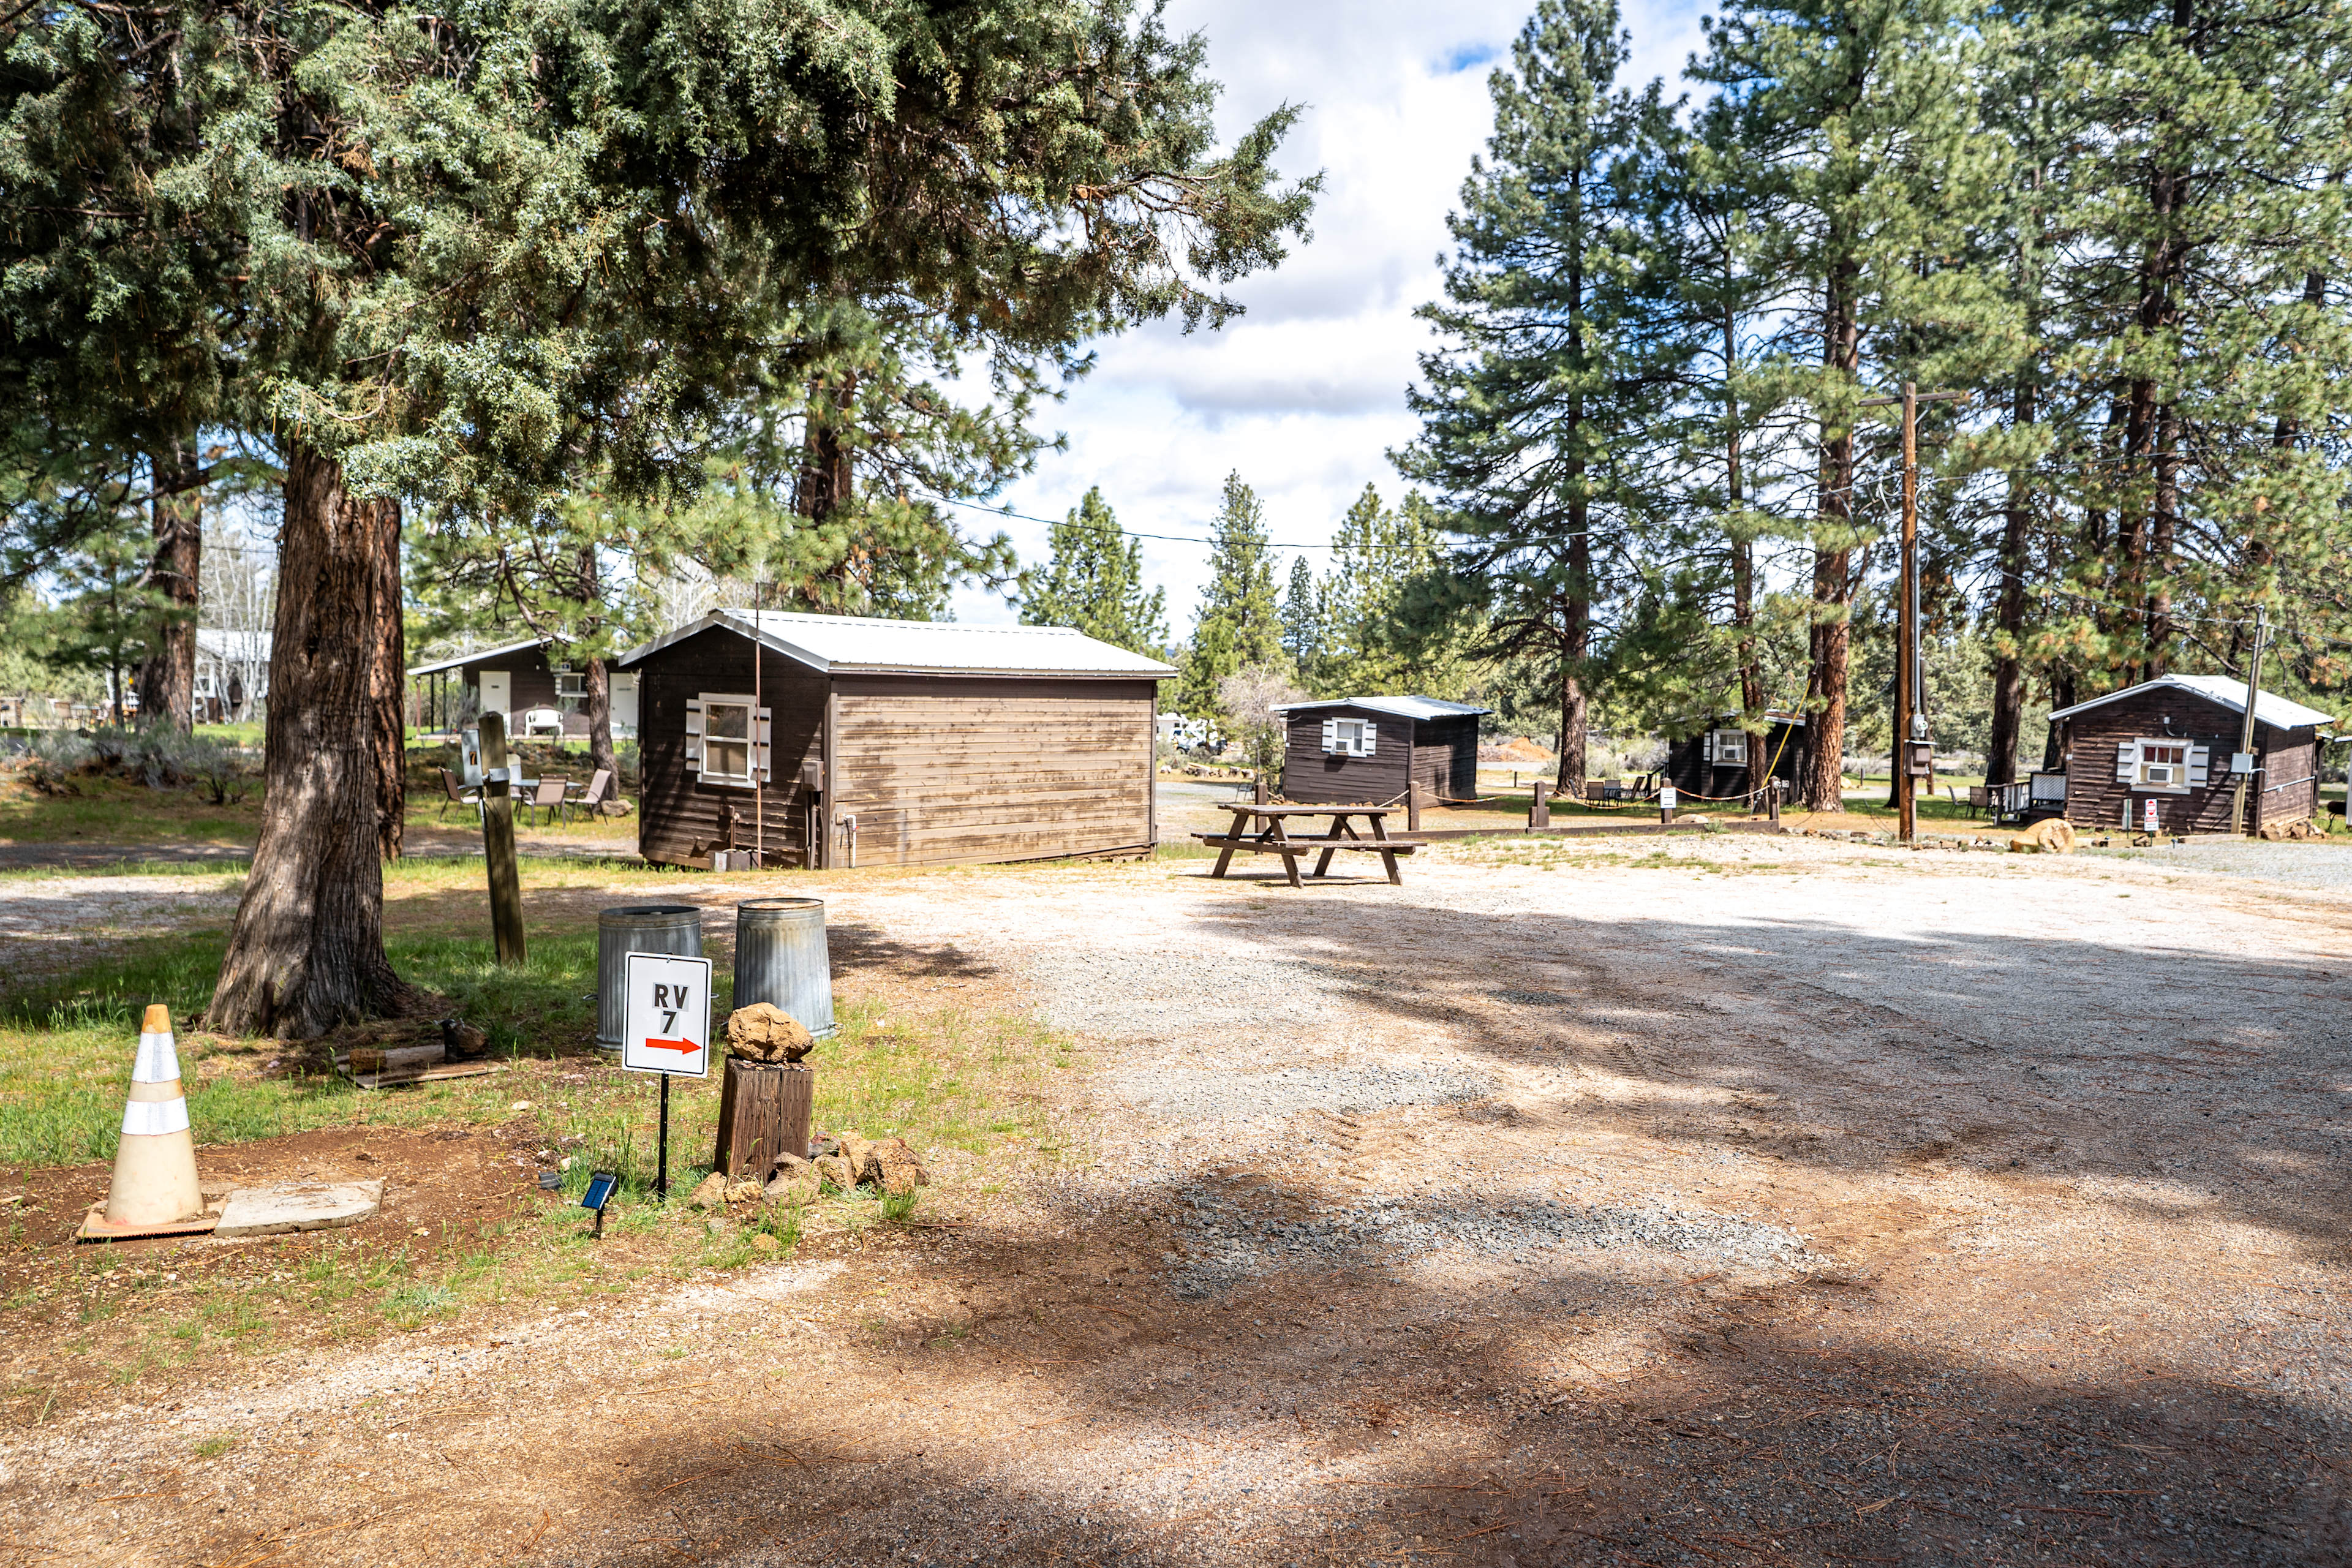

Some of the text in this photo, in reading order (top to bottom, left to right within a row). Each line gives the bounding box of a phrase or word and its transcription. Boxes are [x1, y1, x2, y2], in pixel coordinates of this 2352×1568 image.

[469, 751, 477, 765] 7
[654, 984, 688, 1009] RV
[662, 1010, 677, 1034] 7
